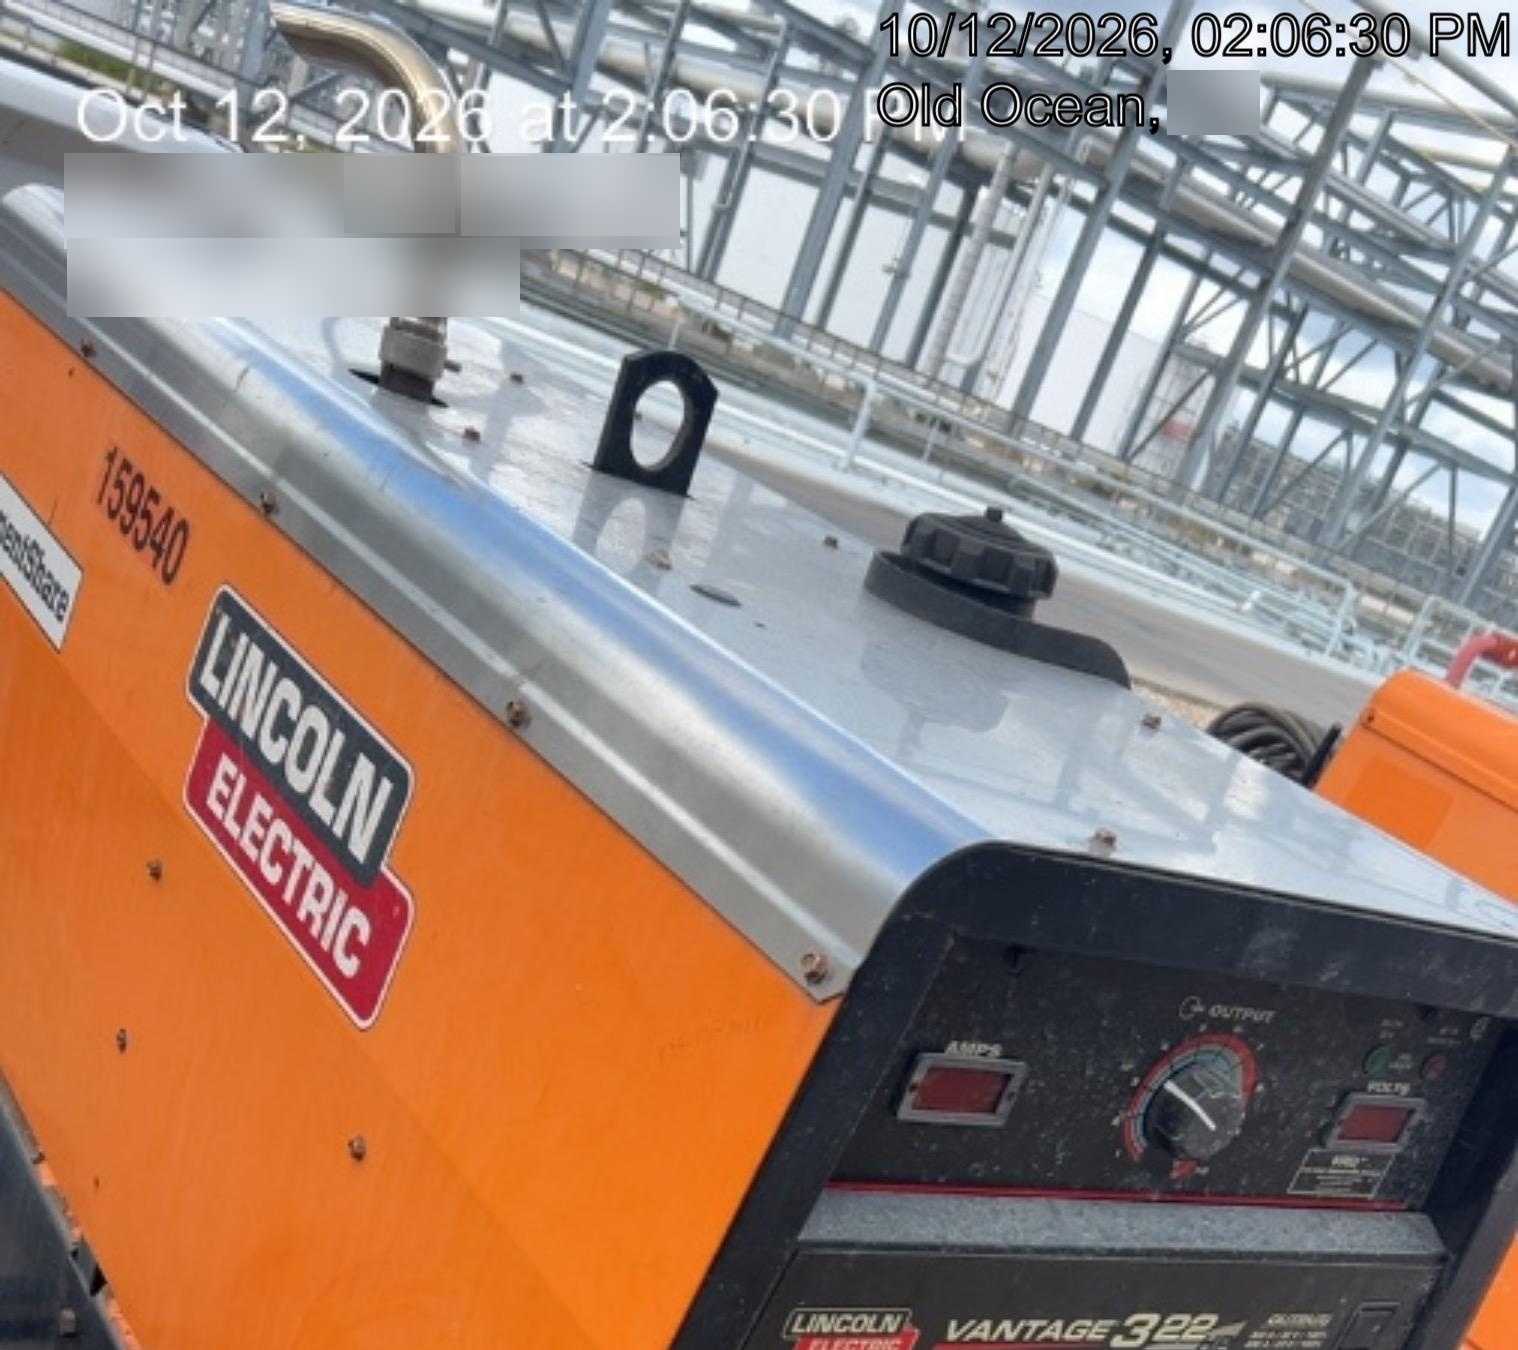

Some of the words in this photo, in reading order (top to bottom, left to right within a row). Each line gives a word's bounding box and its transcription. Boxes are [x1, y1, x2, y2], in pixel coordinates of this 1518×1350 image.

[97, 447, 190, 585] 159540
[200, 614, 394, 866] LINCOLN
[206, 752, 371, 979] ELECTRIC
[1208, 1004, 1276, 1024] OUTPUT
[944, 1040, 1003, 1058] AMPS
[791, 1313, 904, 1333] LINCOLN
[946, 1318, 1121, 1342] VANTAGE
[1110, 1312, 1220, 1348] 322
